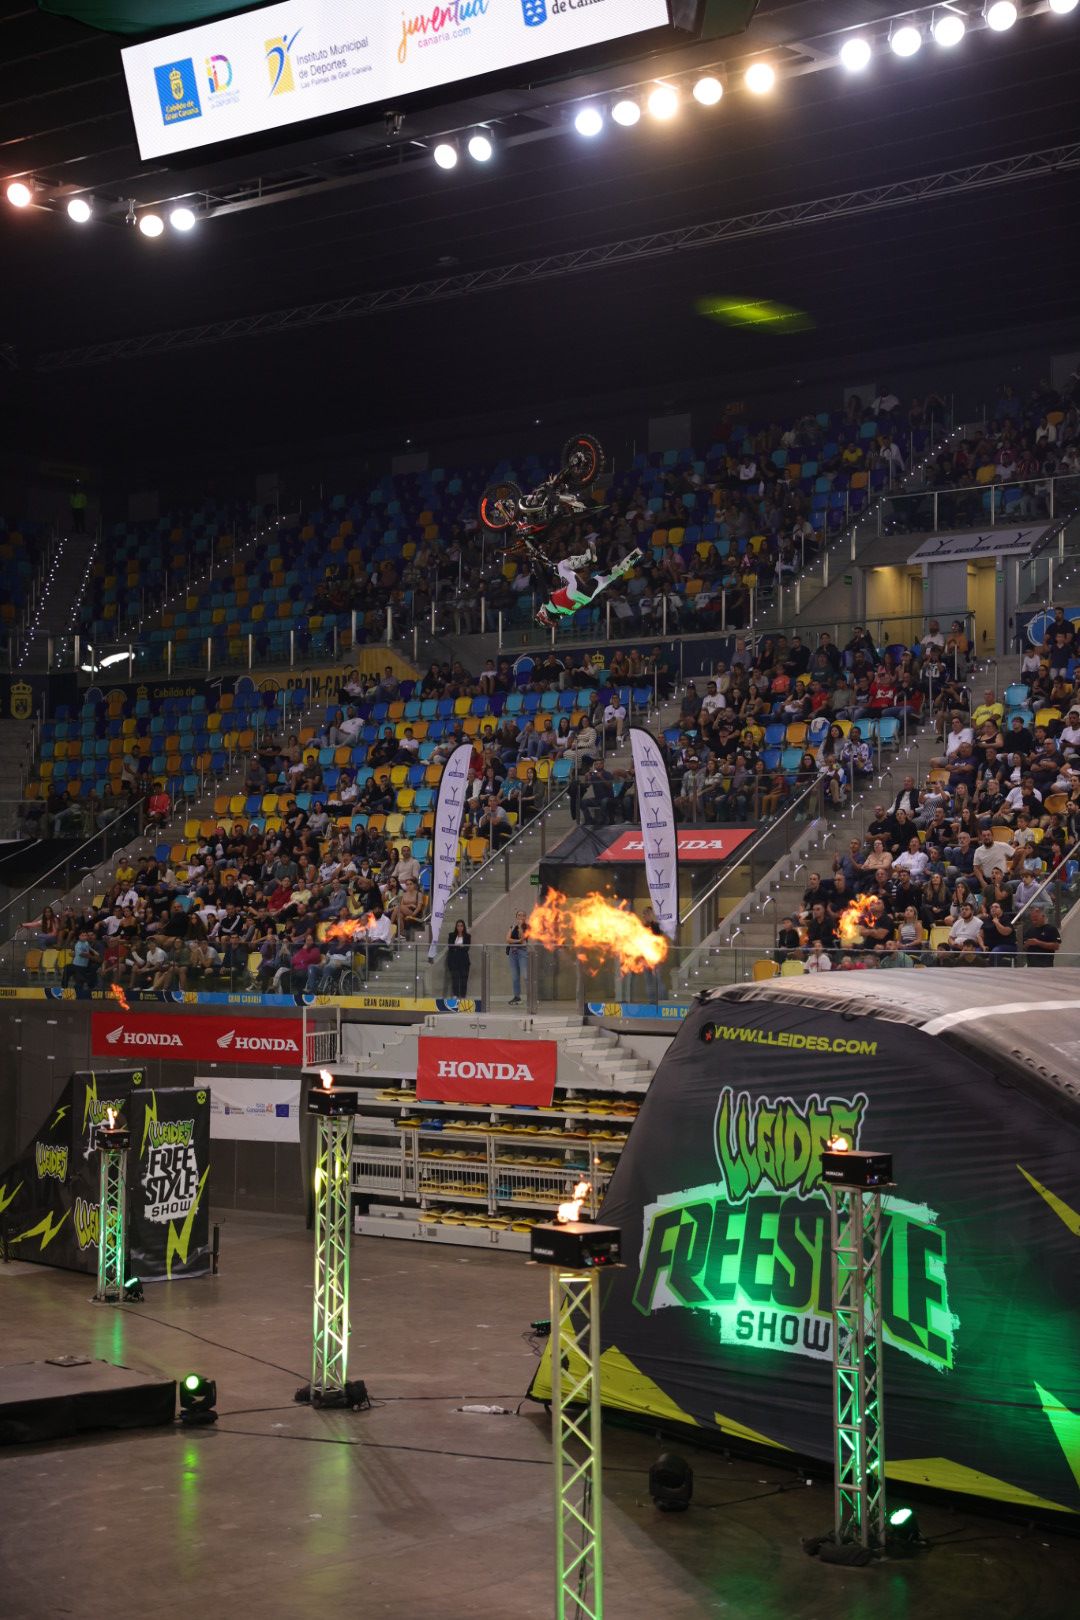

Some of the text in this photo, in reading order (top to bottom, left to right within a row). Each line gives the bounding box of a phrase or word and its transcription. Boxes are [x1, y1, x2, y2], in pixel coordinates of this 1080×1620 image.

[417, 26, 471, 48] canaria.com
[296, 36, 369, 65] Instituto Municipal
[298, 58, 347, 78] de Deportes
[363, 998, 401, 1008] GRAN CANARIA
[661, 1007, 678, 1017] GRAN
[123, 1032, 183, 1046] HONDA
[235, 1037, 299, 1051] HONDA
[437, 1060, 534, 1081] HONDA
[151, 1202, 192, 1217] SHOW
[736, 1310, 833, 1353] SHOW
